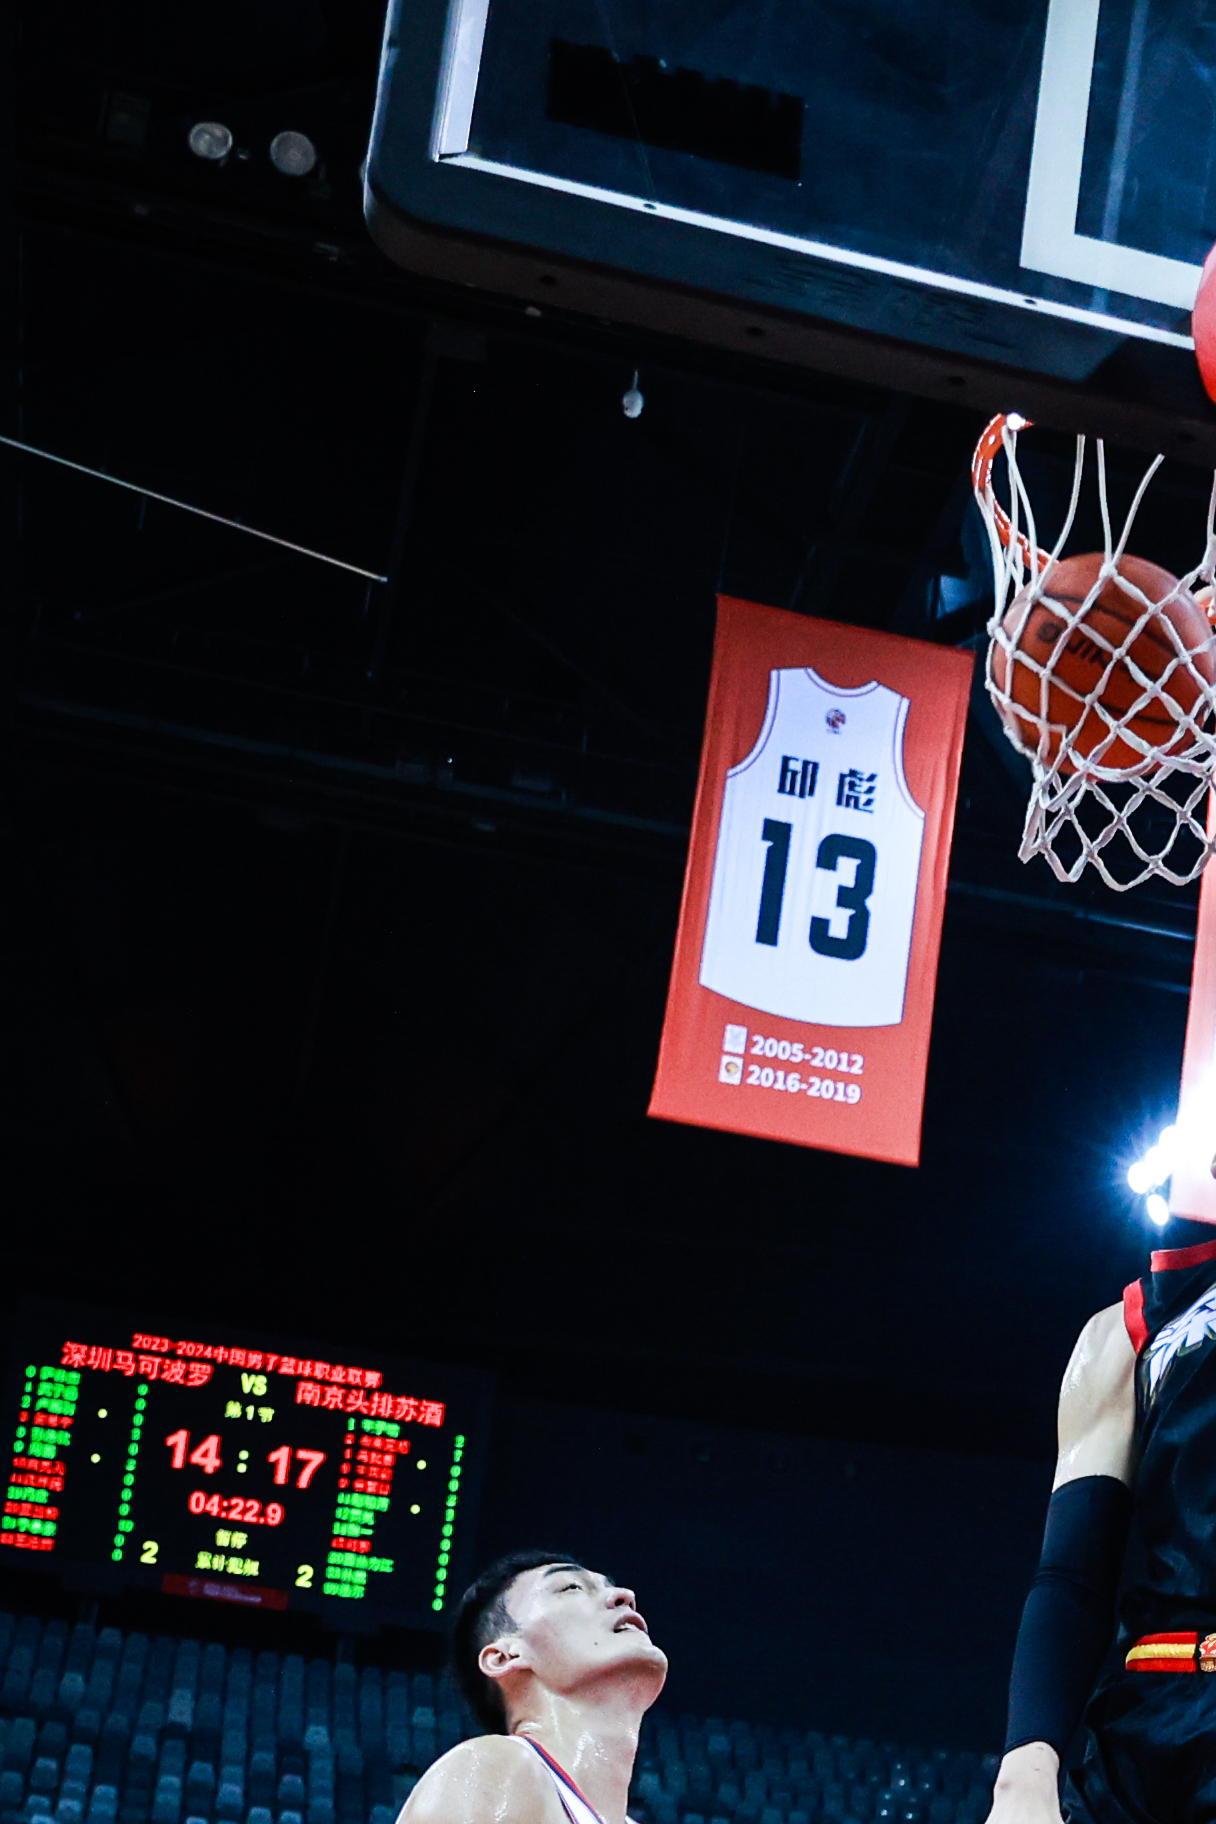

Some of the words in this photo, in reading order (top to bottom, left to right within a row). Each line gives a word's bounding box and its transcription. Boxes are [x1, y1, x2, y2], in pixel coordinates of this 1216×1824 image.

[777, 754, 877, 814] 邱彪
[755, 816, 878, 962] 13
[751, 1034, 864, 1076] 2005-2012
[746, 1064, 862, 1104] 2016-2019
[60, 1340, 214, 1387] 深圳马可波罗
[240, 1372, 268, 1397] VS
[295, 1380, 446, 1428] 南京头排苏酒
[166, 1428, 223, 1475] 14
[267, 1445, 327, 1489] 17
[187, 1490, 285, 1527] 04:22.9
[139, 1540, 159, 1565] 2
[295, 1564, 314, 1588] 2
